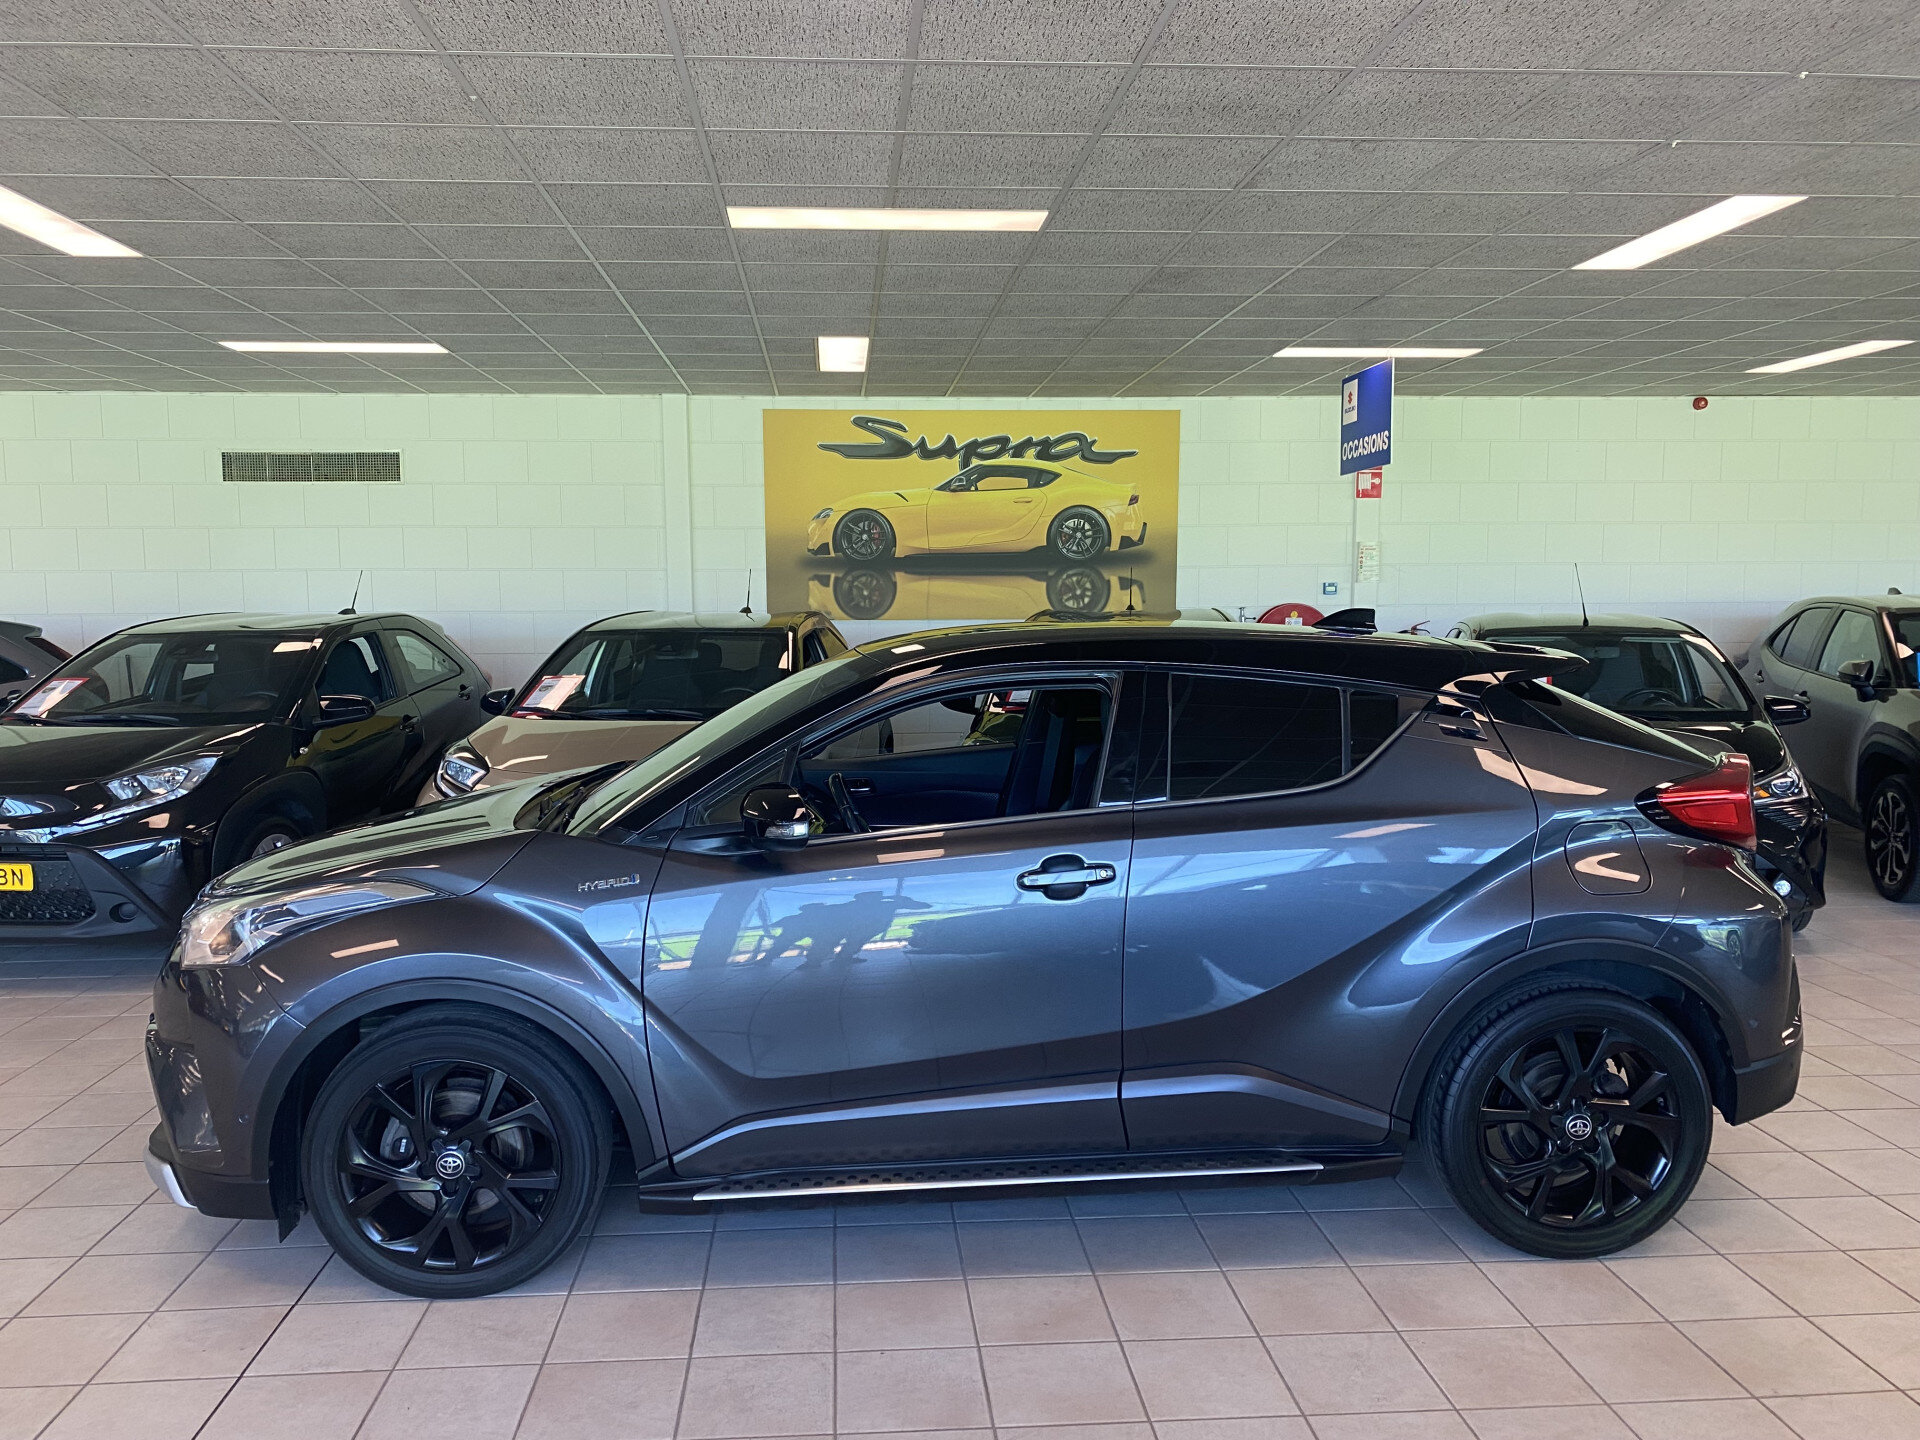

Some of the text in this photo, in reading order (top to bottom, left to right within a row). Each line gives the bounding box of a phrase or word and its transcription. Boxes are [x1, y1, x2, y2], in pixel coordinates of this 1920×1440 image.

[1344, 406, 1356, 414] SUZUKI
[817, 414, 1139, 470] Supra
[1342, 430, 1389, 460] OCCASIONS
[577, 877, 630, 892] HYBRID
